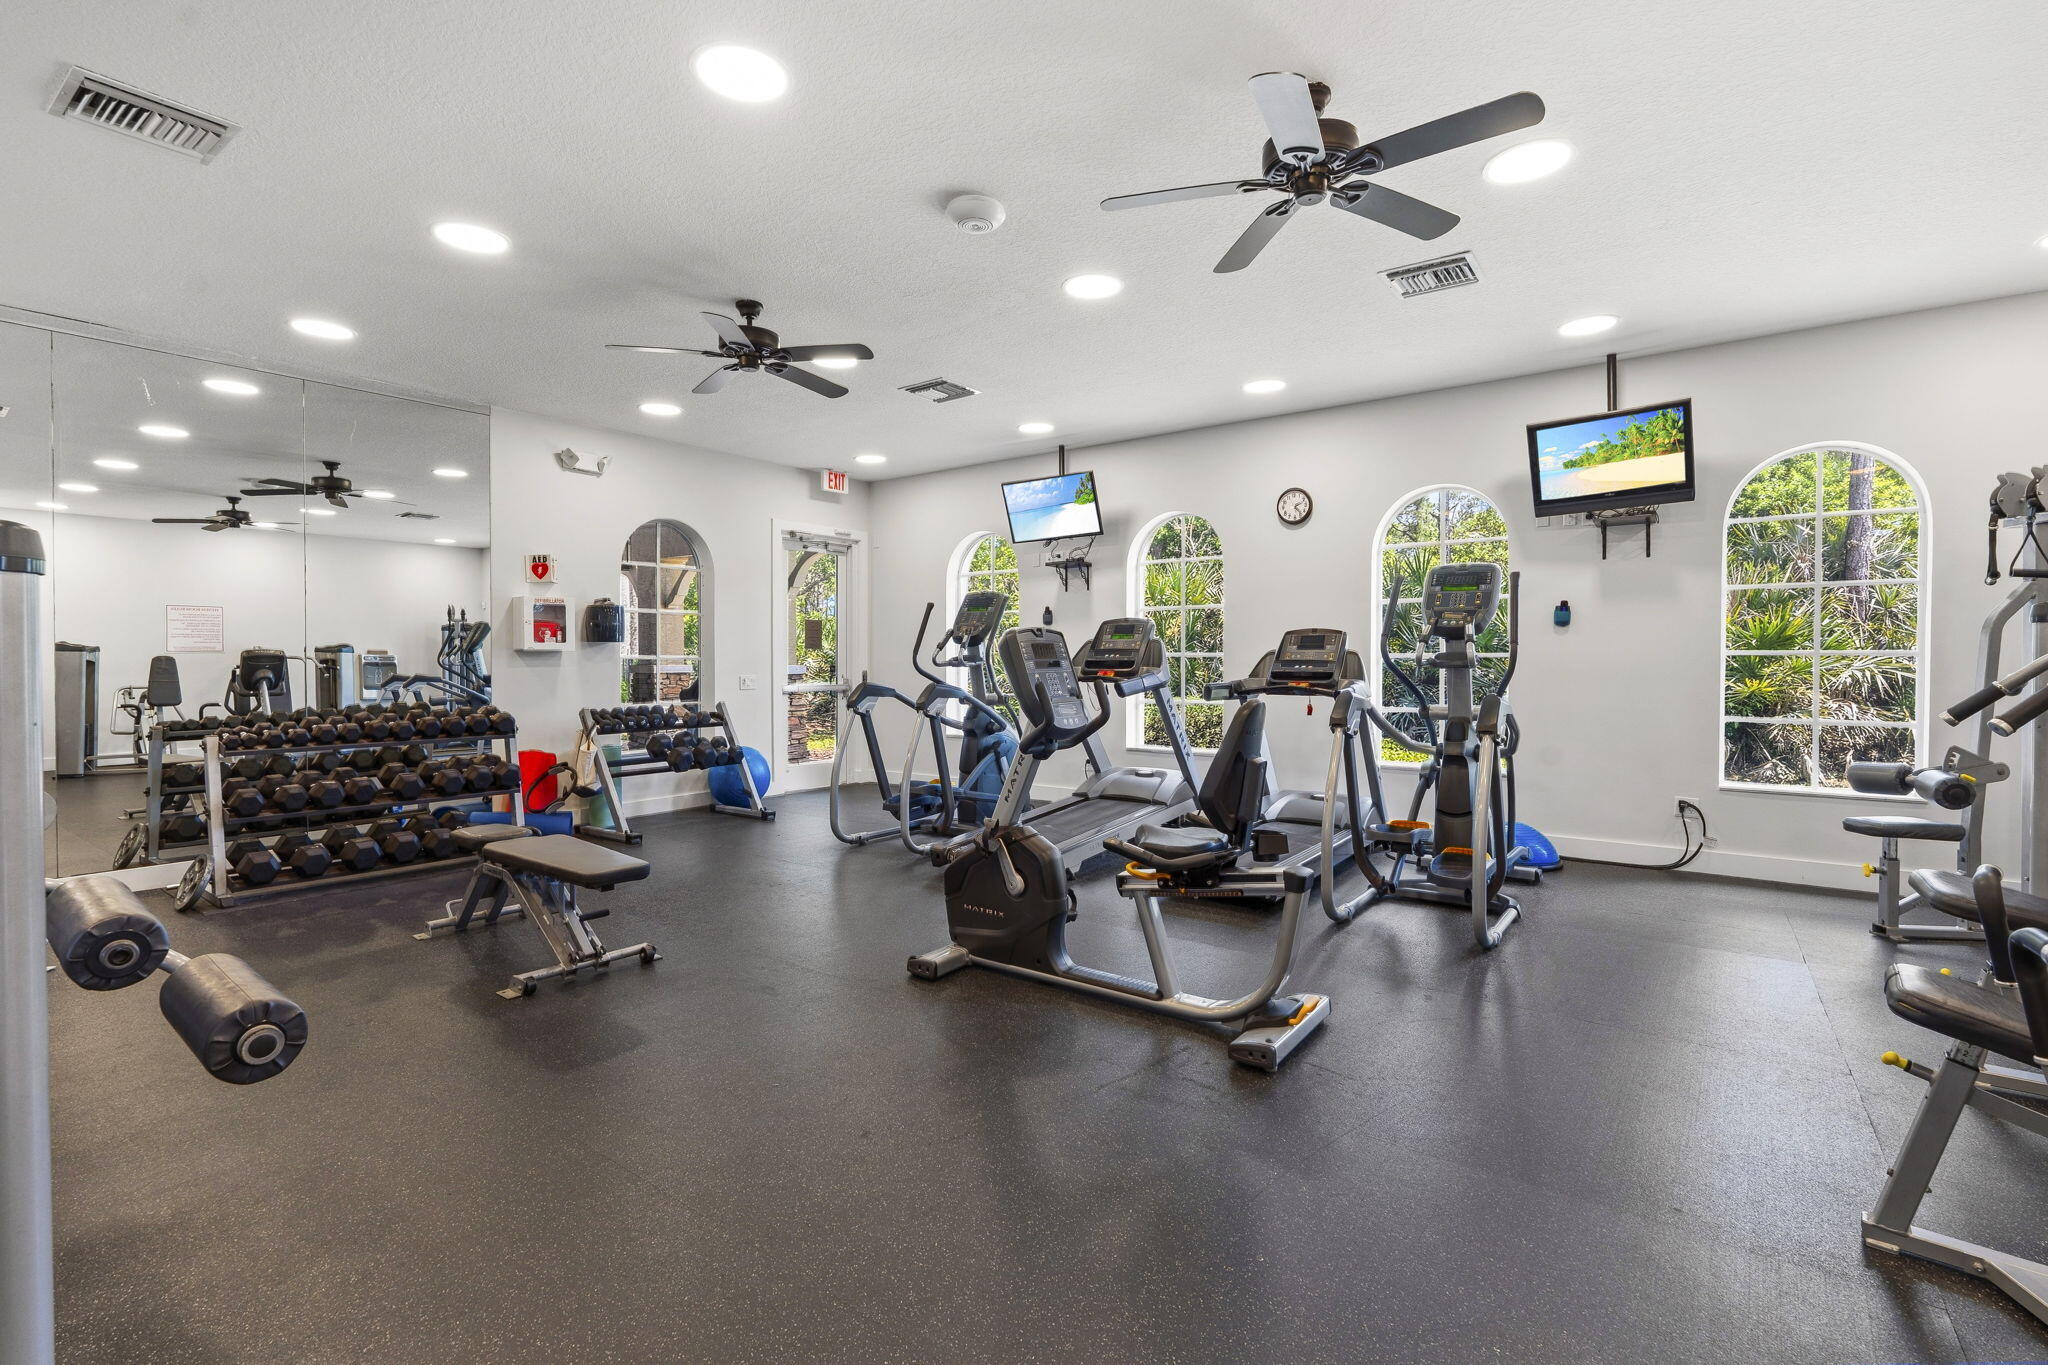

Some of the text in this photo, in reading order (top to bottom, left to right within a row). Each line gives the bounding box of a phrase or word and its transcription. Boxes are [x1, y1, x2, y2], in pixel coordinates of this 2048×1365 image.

[828, 471, 846, 491] EXIT
[532, 555, 548, 563] AED
[1004, 754, 1025, 804] MATR
[963, 903, 1005, 918] MATRIX
